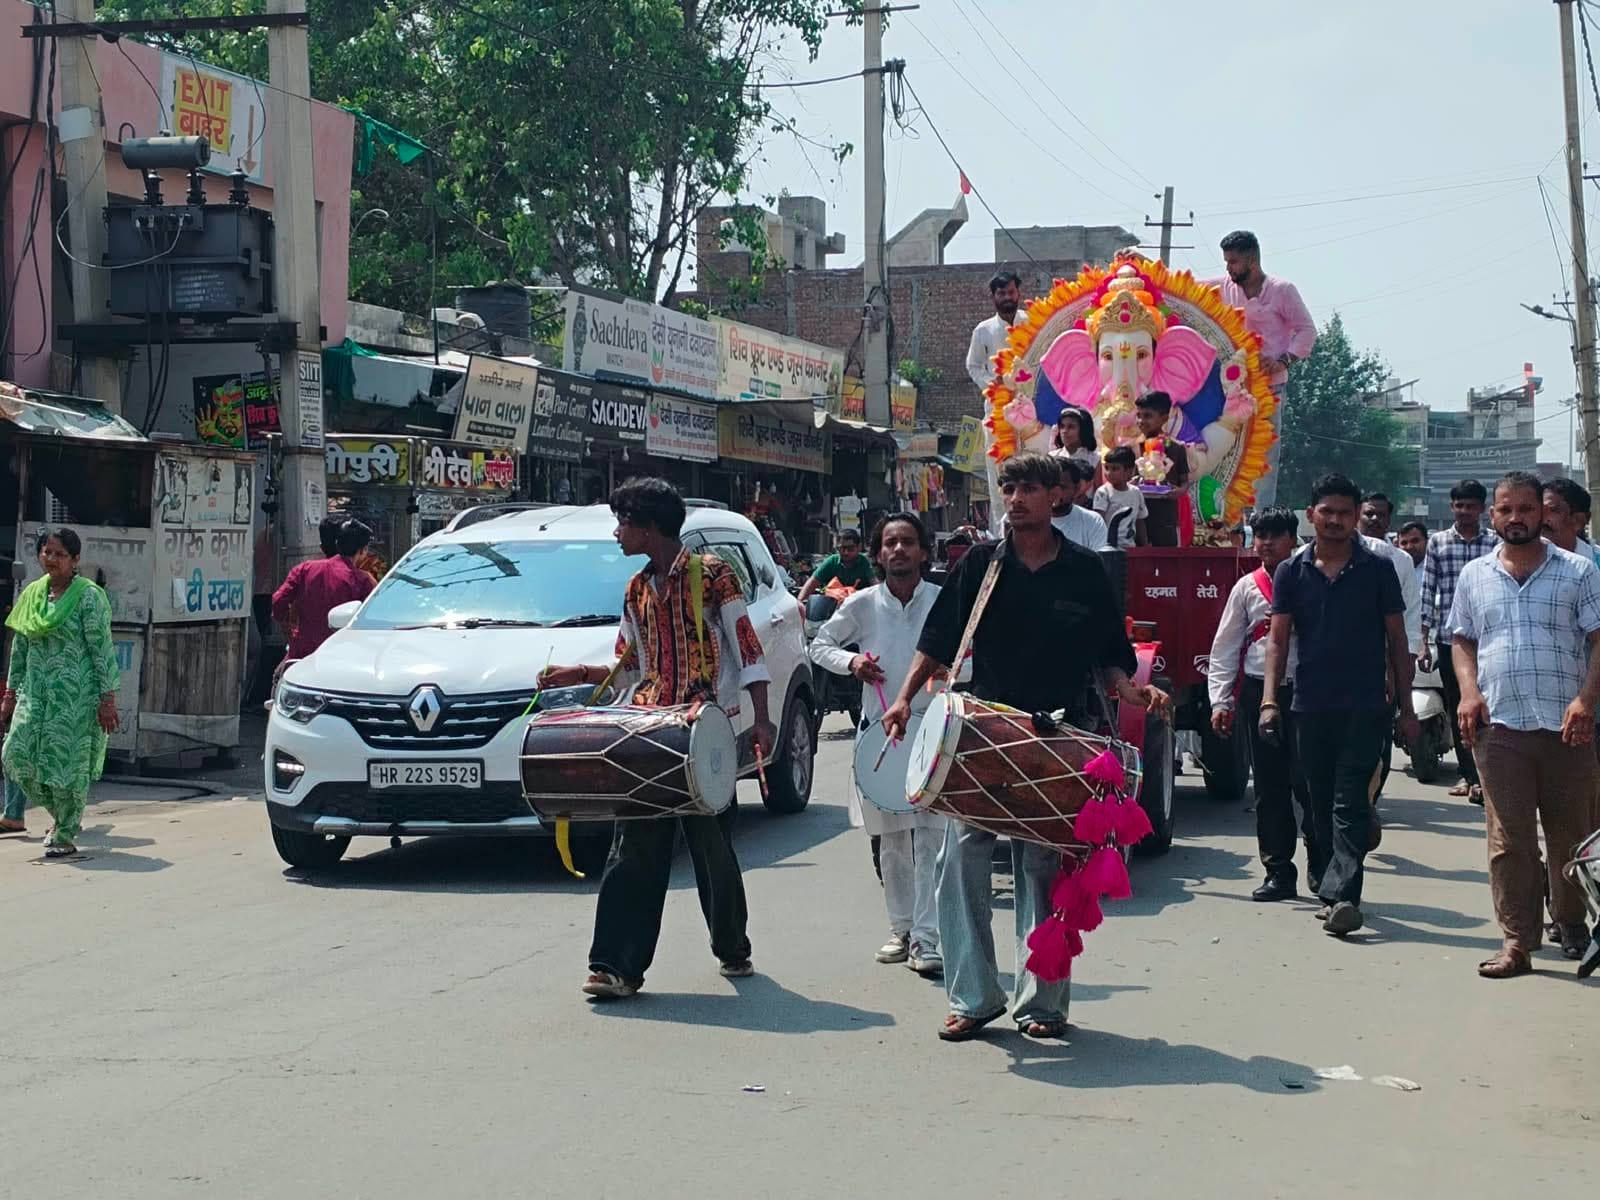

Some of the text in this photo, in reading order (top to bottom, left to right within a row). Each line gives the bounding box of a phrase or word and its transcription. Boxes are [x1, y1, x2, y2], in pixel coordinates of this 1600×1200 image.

[181, 74, 229, 112] EXIT
[179, 107, 227, 145] बाहर
[590, 308, 648, 354] Sachdeva
[300, 361, 320, 381] SIIT
[729, 327, 748, 363] शिव
[786, 352, 804, 386] जूस
[186, 567, 246, 613] टी स्टाल
[1144, 583, 1218, 599] रहमत तेरी
[380, 767, 398, 784] HR
[404, 767, 433, 784] 22S
[439, 766, 479, 784] 9529
